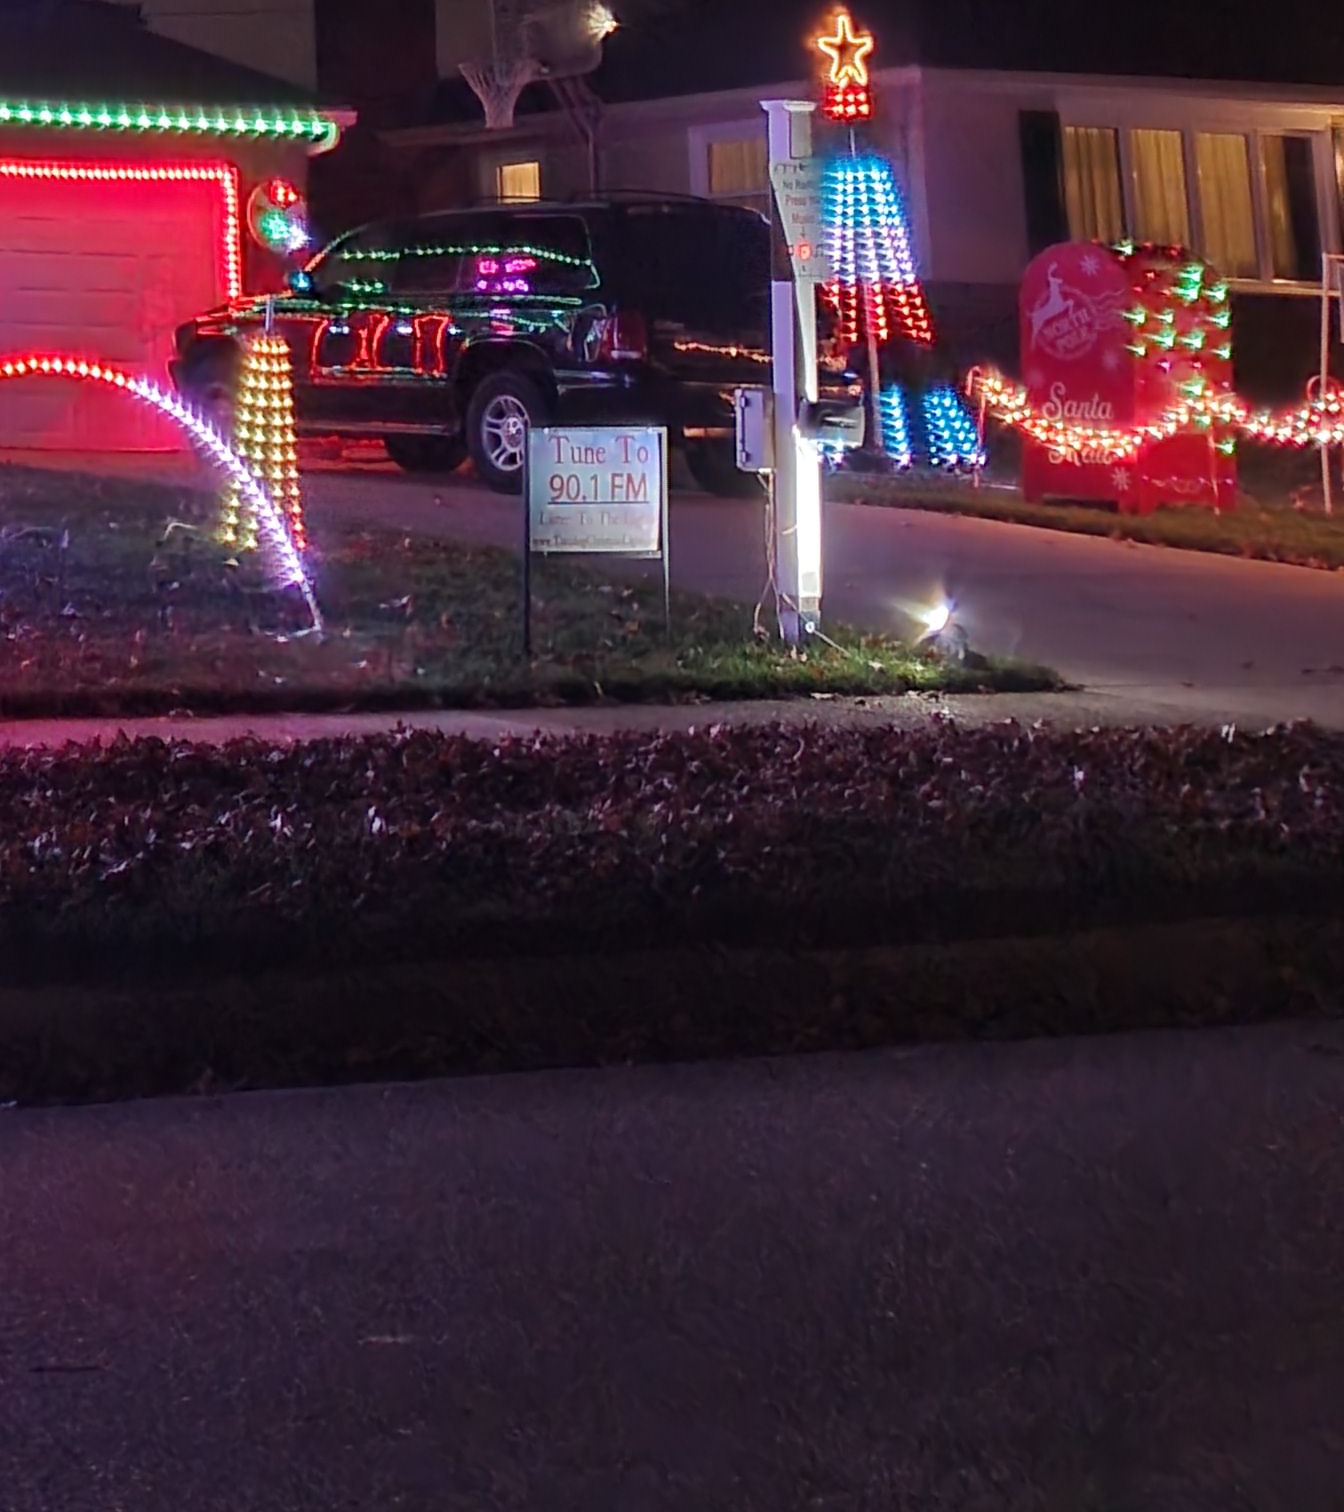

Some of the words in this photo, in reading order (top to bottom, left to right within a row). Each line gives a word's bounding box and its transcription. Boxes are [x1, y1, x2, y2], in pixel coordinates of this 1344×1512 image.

[1042, 382, 1114, 421] Santa
[548, 435, 606, 465] Tune
[614, 435, 649, 464] To
[548, 473, 600, 501] 90.1
[611, 472, 648, 501] FM
